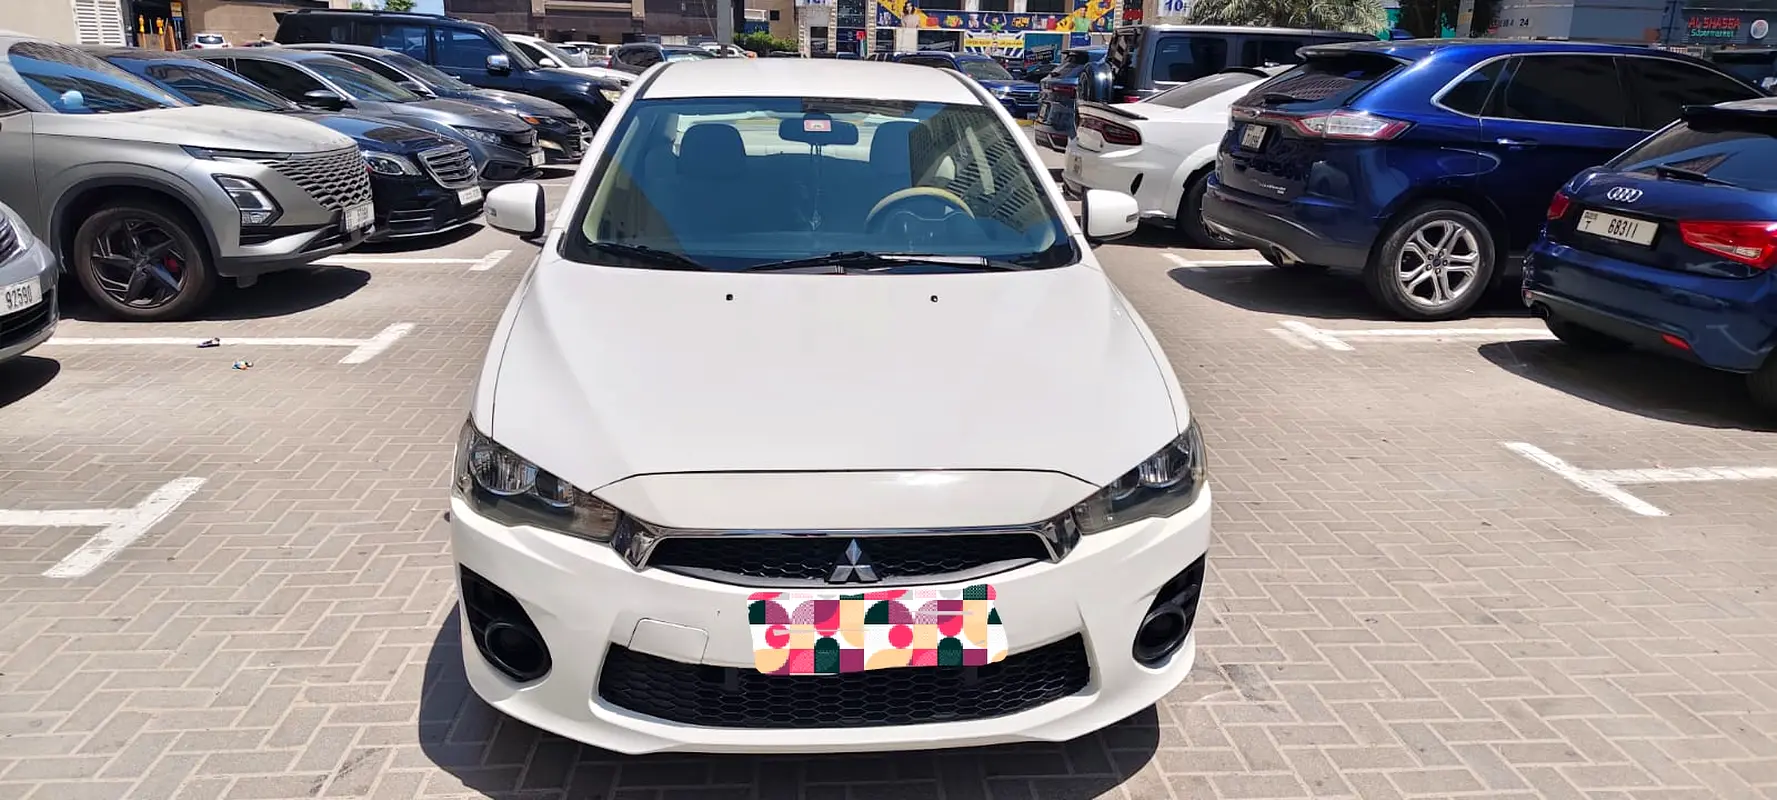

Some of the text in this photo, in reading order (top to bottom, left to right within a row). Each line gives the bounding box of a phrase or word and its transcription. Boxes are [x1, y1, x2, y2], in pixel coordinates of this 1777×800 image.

[1519, 18, 1529, 27] 24
[1688, 17, 1701, 28] AL
[1607, 219, 1639, 239] 68311
[5, 284, 33, 309] 92590
